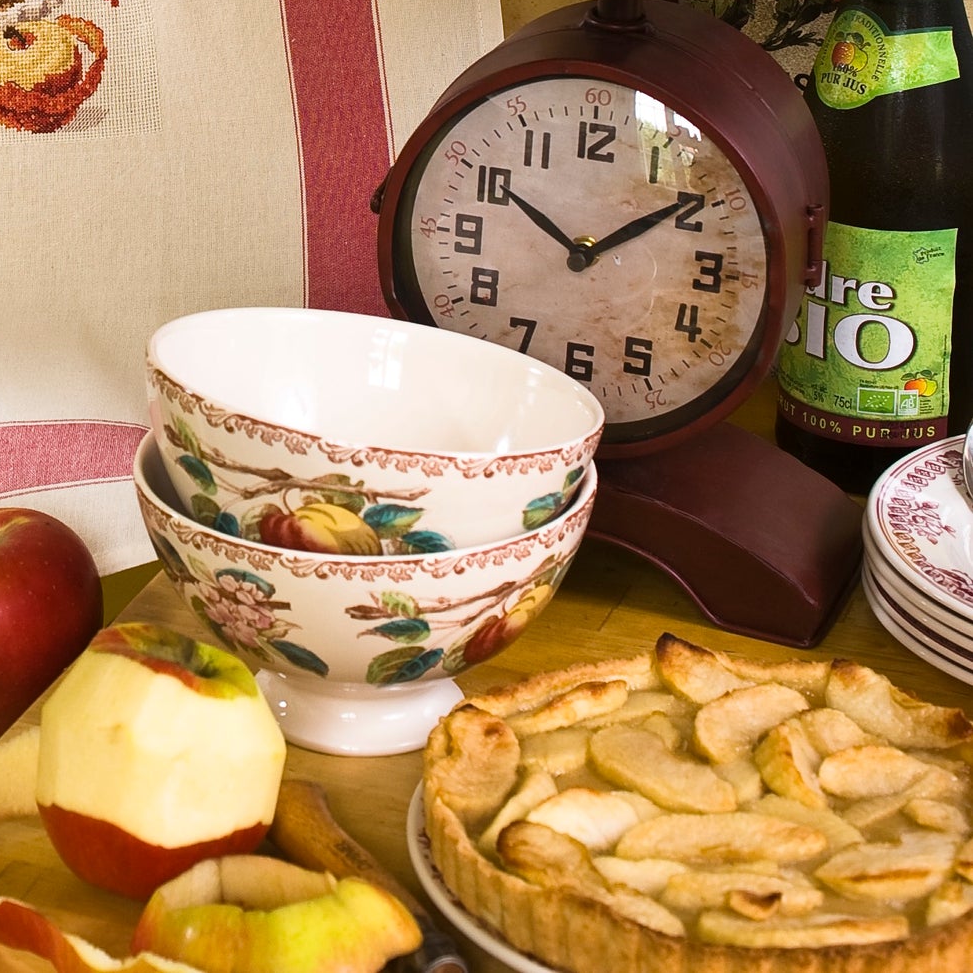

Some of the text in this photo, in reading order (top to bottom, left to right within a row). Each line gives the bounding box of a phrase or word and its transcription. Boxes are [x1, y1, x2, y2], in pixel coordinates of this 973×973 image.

[585, 87, 612, 107] 60
[820, 72, 841, 84] PUR
[842, 77, 867, 95] JUS
[506, 95, 527, 117] 55
[444, 140, 468, 166] 50
[523, 129, 551, 169] 11
[577, 121, 617, 163] 12
[477, 165, 512, 207] 10
[724, 187, 747, 211] 10
[419, 216, 438, 239] 45
[674, 190, 706, 233] 2
[454, 212, 484, 255] 9
[470, 266, 500, 307] 8
[692, 250, 724, 294] 3
[740, 271, 759, 291] 15
[433, 293, 456, 319] 40
[674, 302, 702, 343] 4
[509, 316, 538, 355] 7
[708, 339, 732, 367] 20
[784, 300, 915, 370] IO
[565, 341, 595, 382] 6
[623, 335, 653, 377] 5
[644, 388, 667, 410] 25
[777, 390, 936, 439] RUT 100% PUR JUS
[833, 394, 853, 410] 75cl
